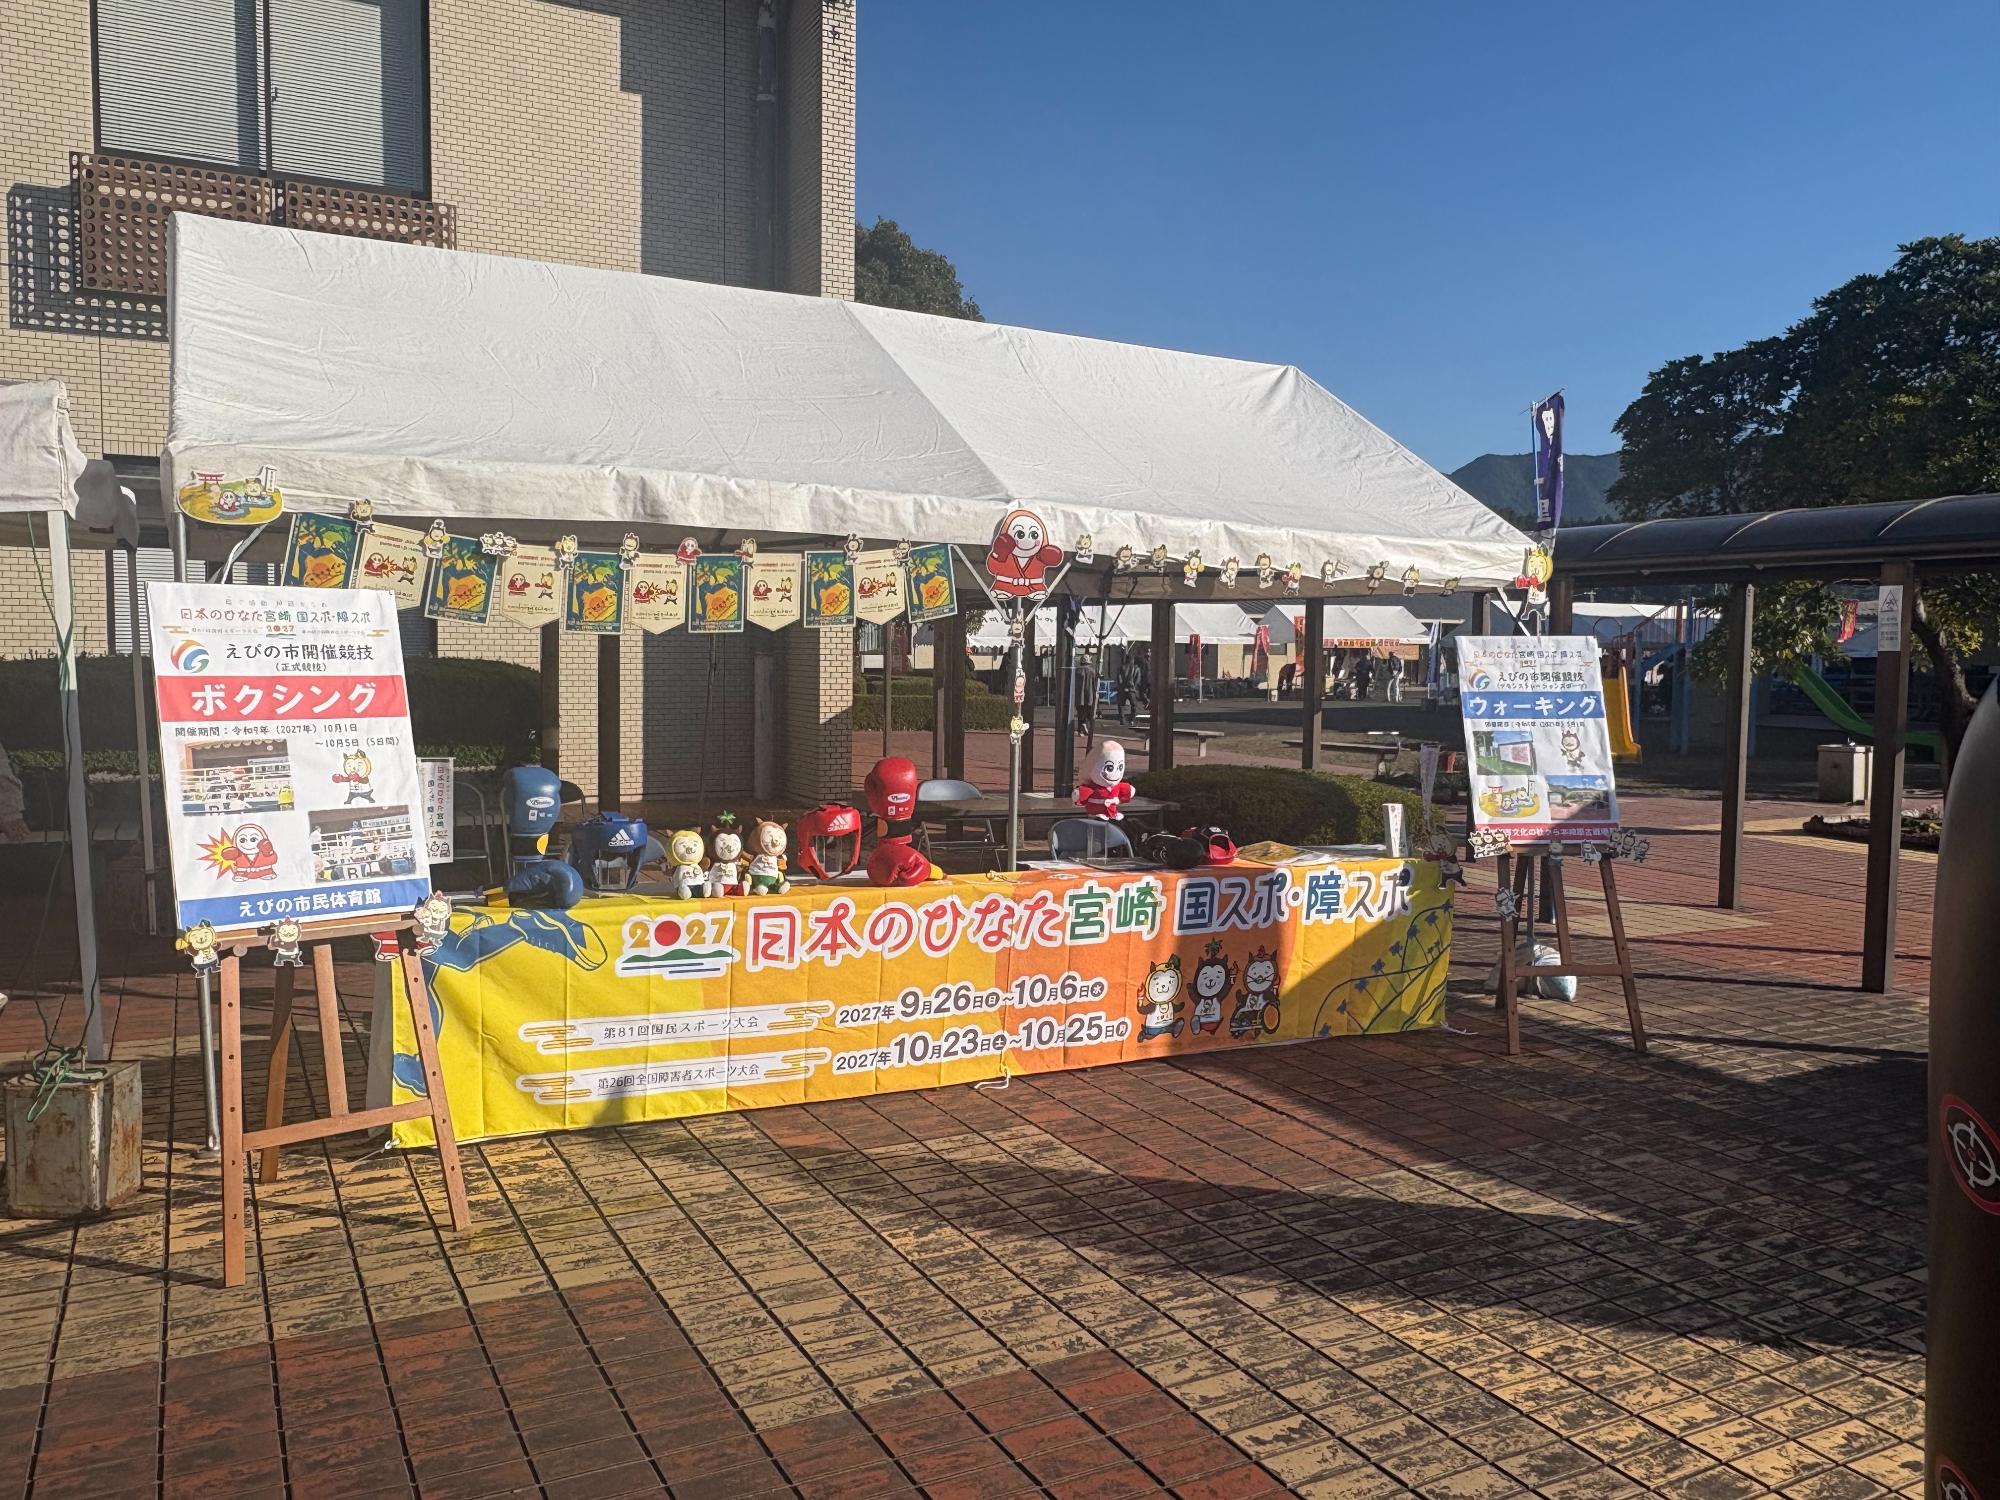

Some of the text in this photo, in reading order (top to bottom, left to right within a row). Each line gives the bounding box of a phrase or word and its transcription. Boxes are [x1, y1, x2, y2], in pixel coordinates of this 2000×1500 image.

[180, 608, 291, 623] 日本のひなた宮崎
[226, 643, 374, 661] えびの市開催競技
[191, 681, 377, 716] ボクシング
[1469, 695, 1597, 716] ウォーキング
[239, 888, 382, 917] えびの市民体育館
[751, 881, 1163, 966] 日本のひなた宮崎
[1177, 866, 1411, 932] 国スポ・障スポ
[604, 1015, 760, 1040] 第81回国民スポーツ大会
[598, 1063, 760, 1090] 第26回全国障害者スポーツ大会
